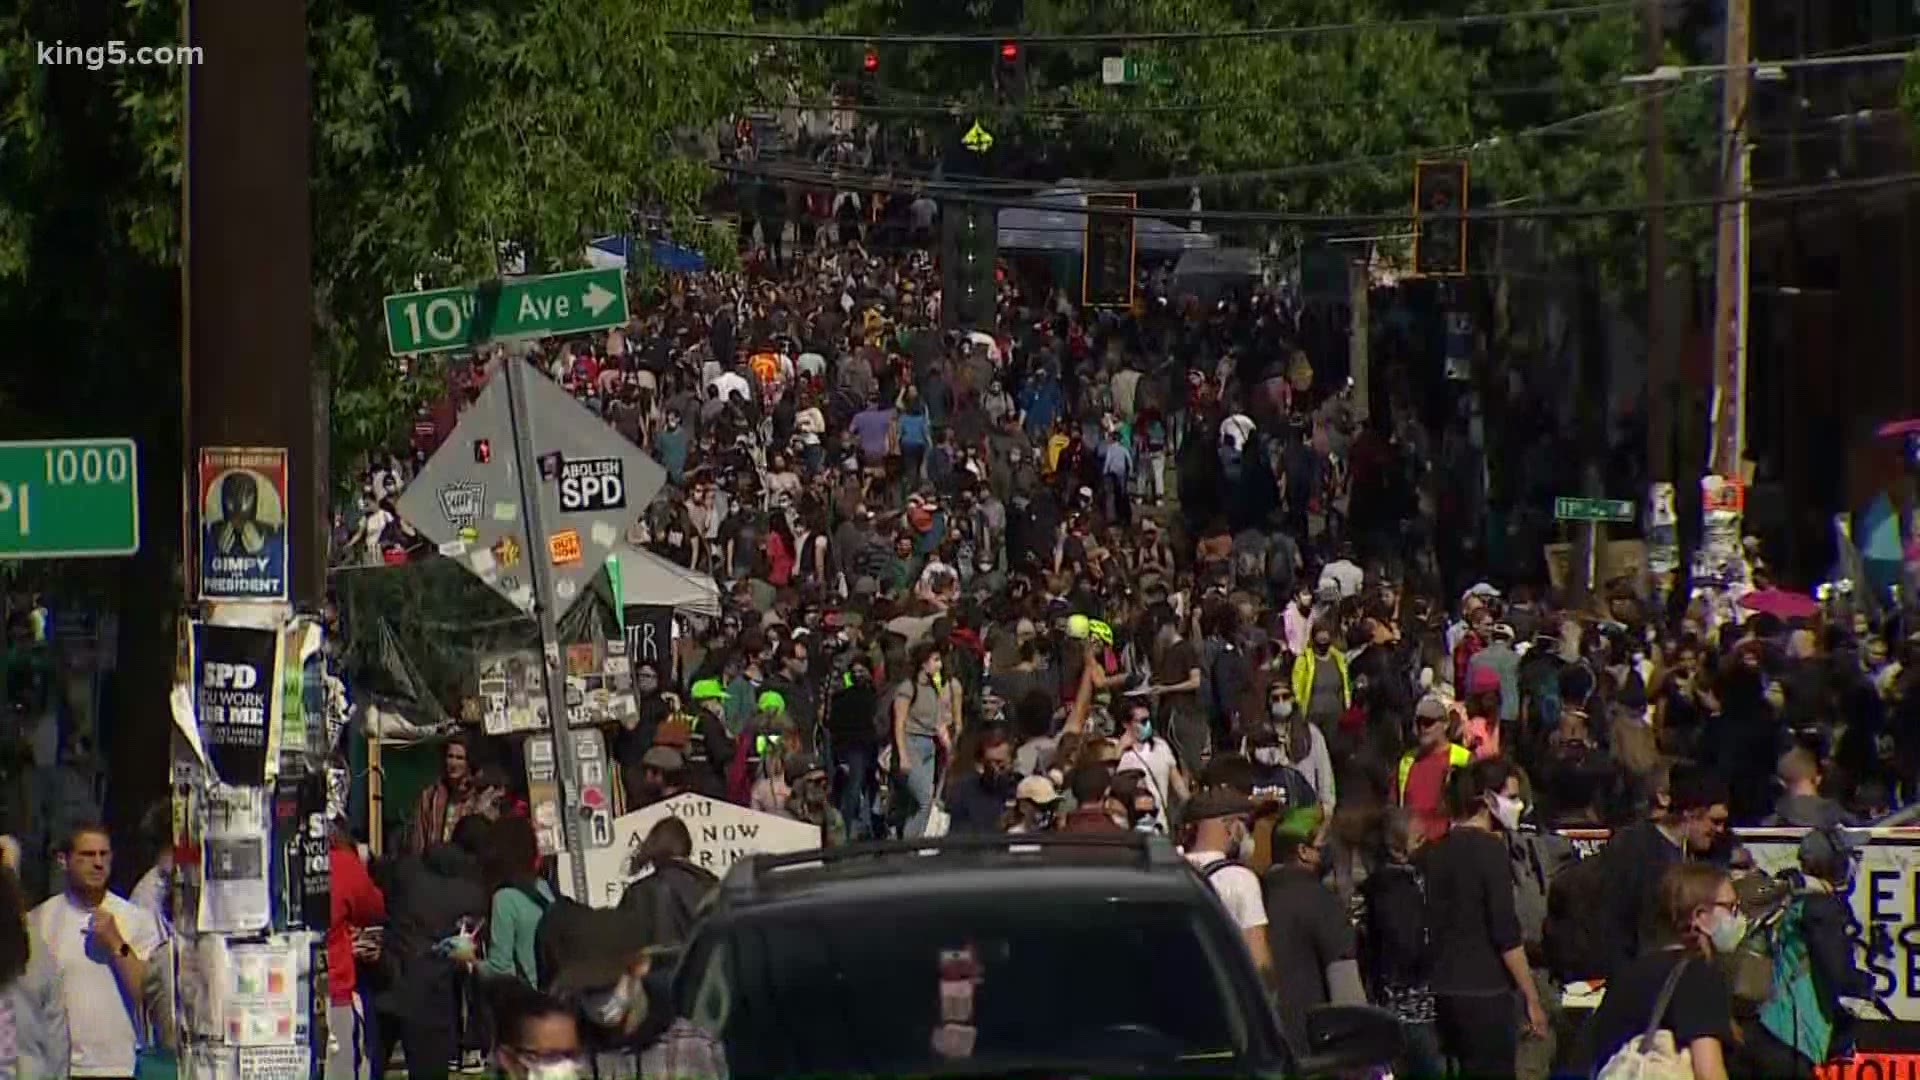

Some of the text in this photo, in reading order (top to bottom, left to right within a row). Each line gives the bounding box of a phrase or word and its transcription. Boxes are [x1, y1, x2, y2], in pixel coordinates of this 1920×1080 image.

[518, 292, 569, 323] Ave
[46, 449, 126, 484] 1000
[562, 462, 619, 479] ABOLISH
[562, 475, 621, 508] SPD
[212, 557, 269, 573] GIMPY
[204, 578, 280, 593] PRESIDENT
[203, 661, 257, 689] SPD
[219, 690, 265, 707] WORK
[230, 707, 265, 725] ME
[665, 802, 712, 818] YOU
[703, 825, 759, 842] NOW
